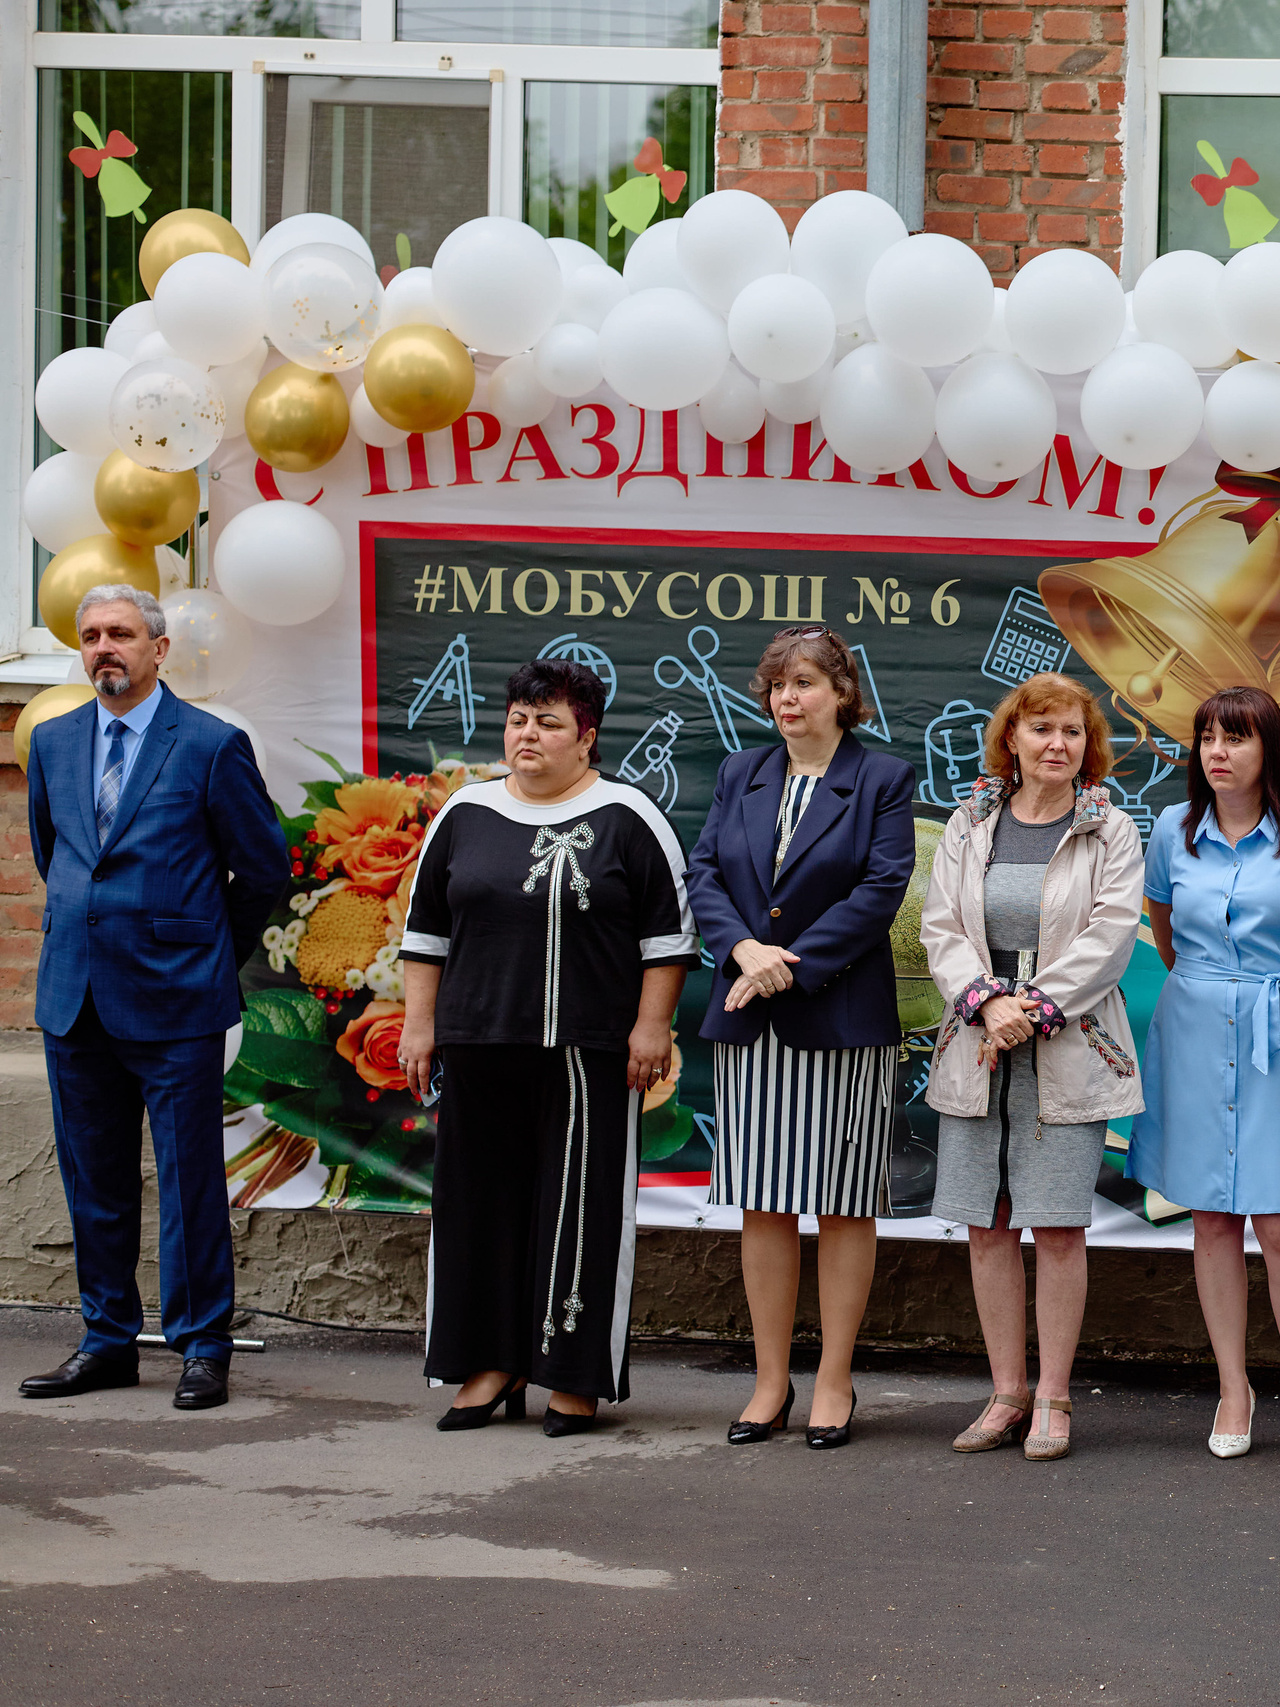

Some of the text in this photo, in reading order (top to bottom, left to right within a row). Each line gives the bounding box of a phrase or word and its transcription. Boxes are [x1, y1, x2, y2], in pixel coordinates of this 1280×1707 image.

[414, 564, 962, 627] #МОБУСОШ № 6
